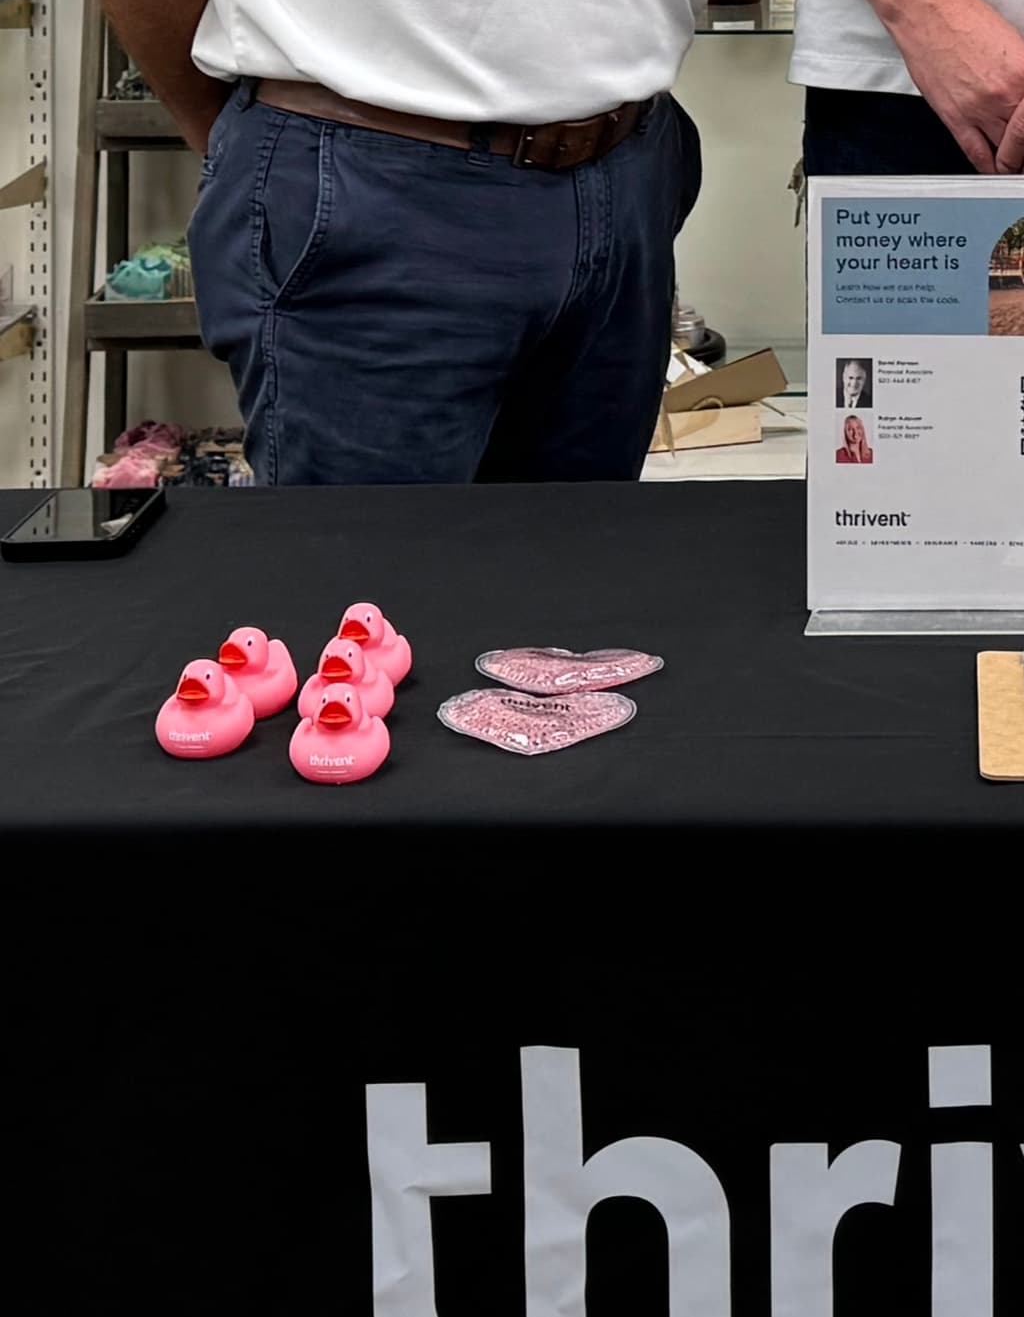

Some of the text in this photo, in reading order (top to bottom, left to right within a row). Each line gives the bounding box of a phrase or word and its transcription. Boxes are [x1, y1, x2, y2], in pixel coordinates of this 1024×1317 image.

[836, 209, 920, 228] Put your
[836, 232, 967, 250] money where
[836, 254, 960, 273] your heart is
[835, 509, 910, 527] thrivent
[309, 754, 356, 767] thrivent
